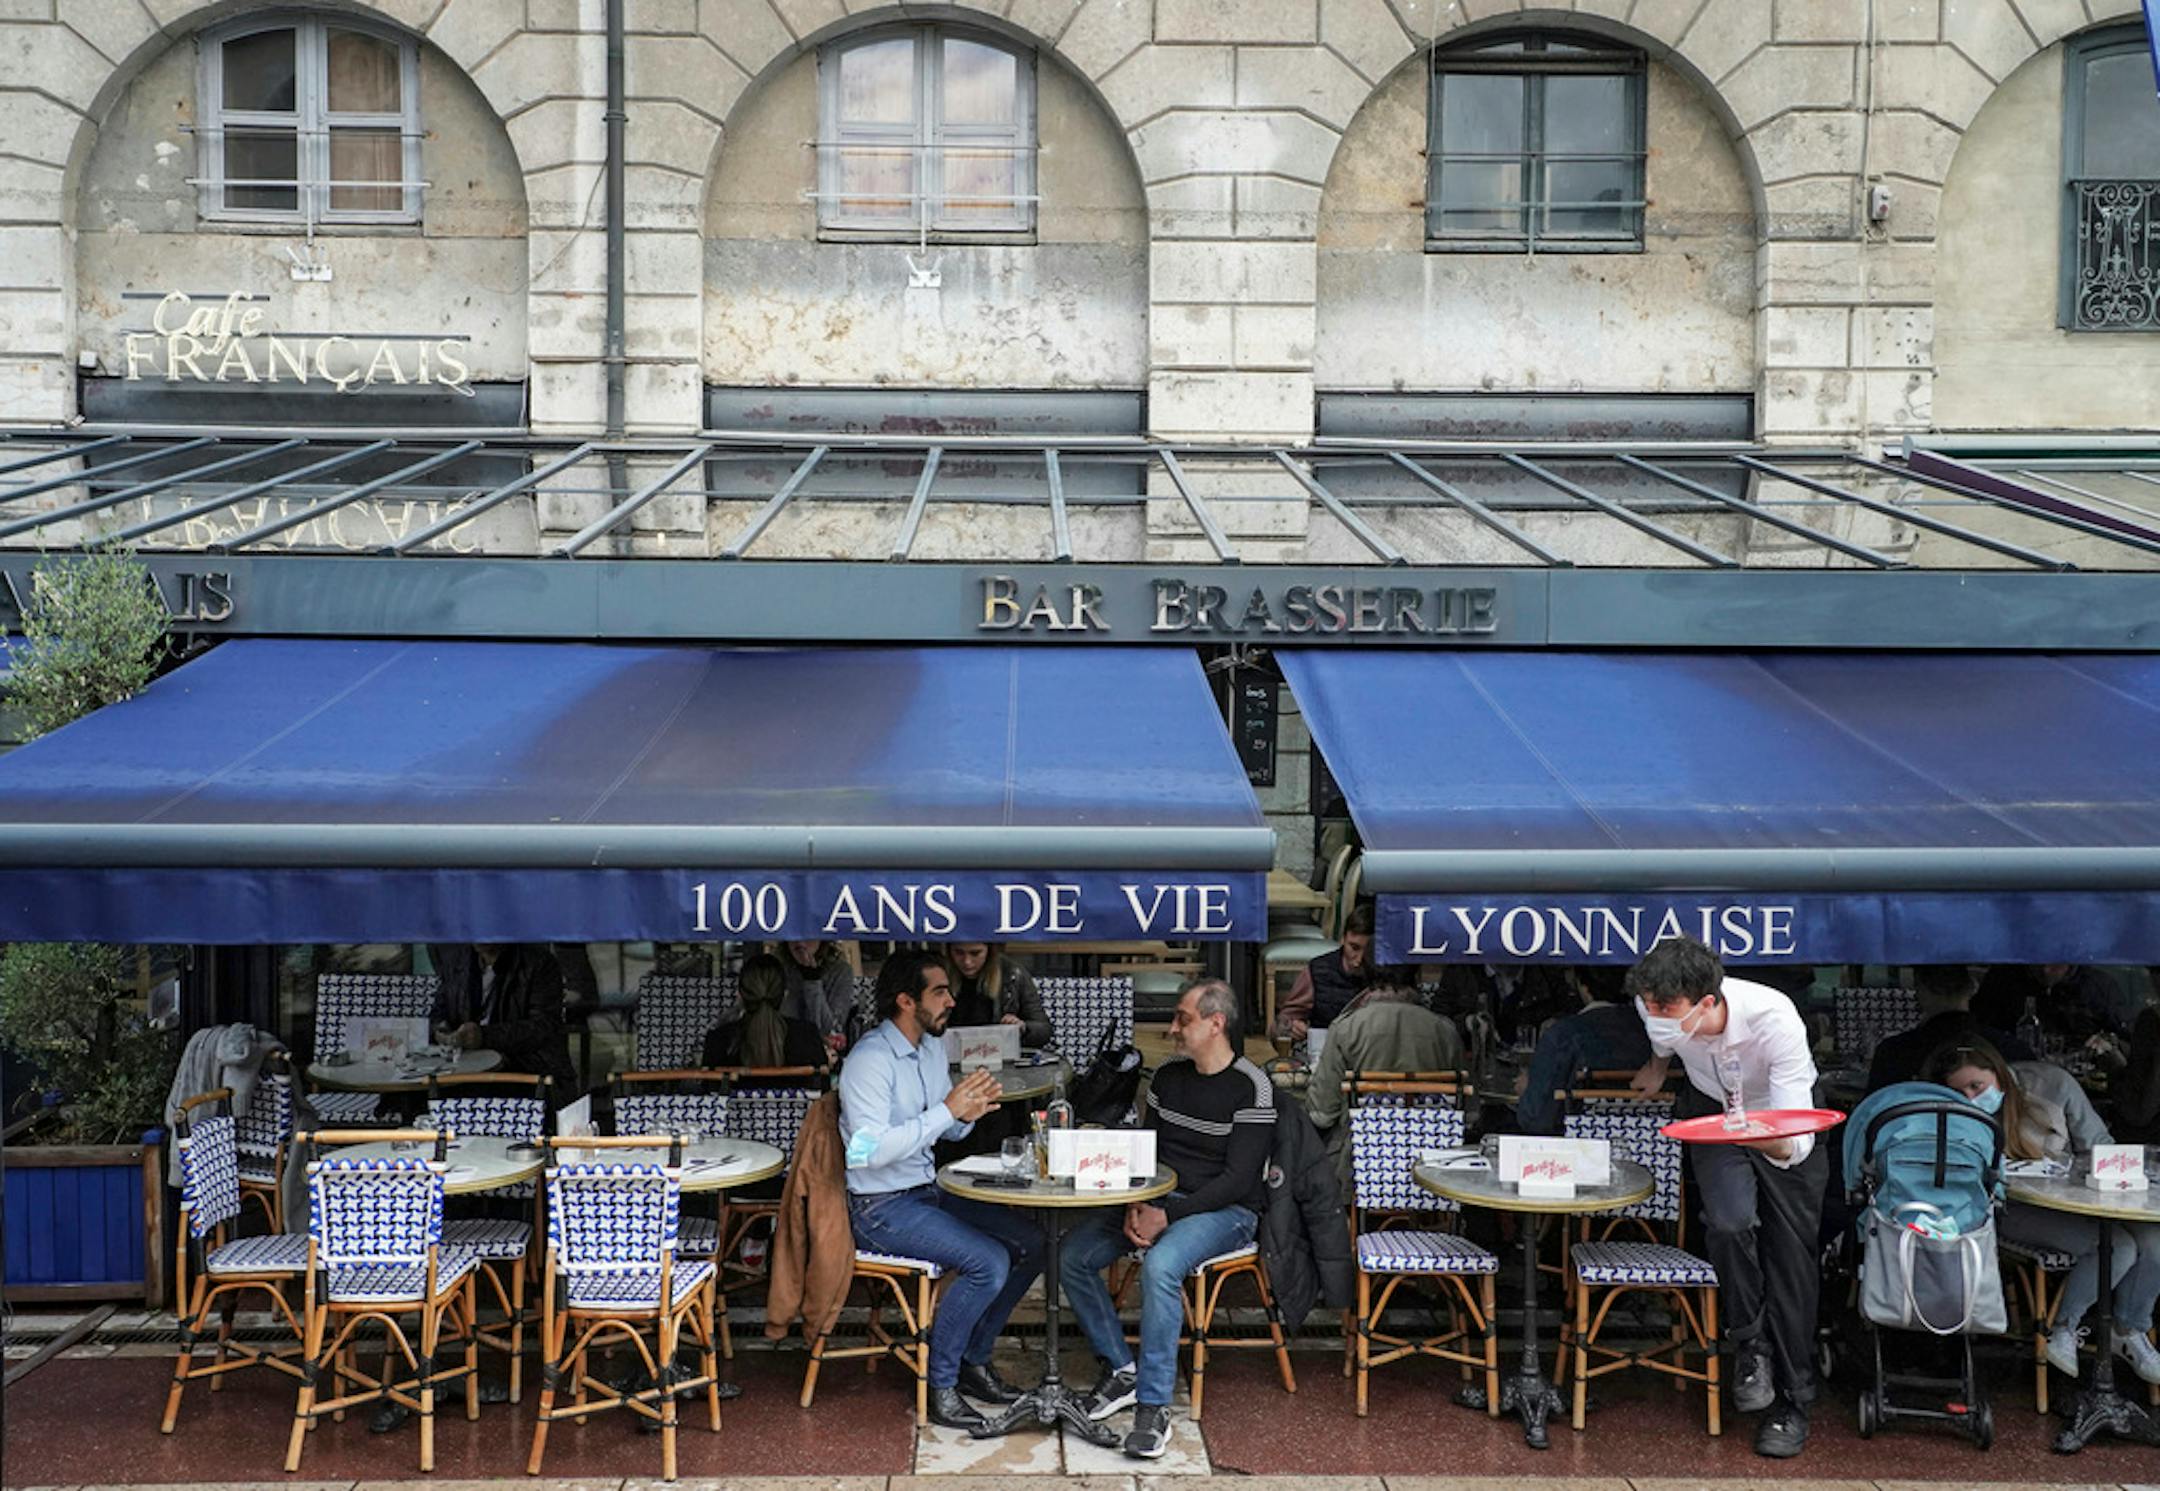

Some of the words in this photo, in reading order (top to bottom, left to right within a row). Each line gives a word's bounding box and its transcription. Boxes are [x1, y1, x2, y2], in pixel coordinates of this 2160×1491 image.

[125, 333, 475, 396] FRANÇAIS
[978, 574, 1112, 631] BAR
[1150, 577, 1498, 634] BRASSERIE
[692, 883, 788, 932] 100
[822, 884, 958, 934] ANS
[994, 883, 1085, 933] DE
[1120, 884, 1233, 933] VIE
[1407, 905, 1796, 956] LYONNAISE
